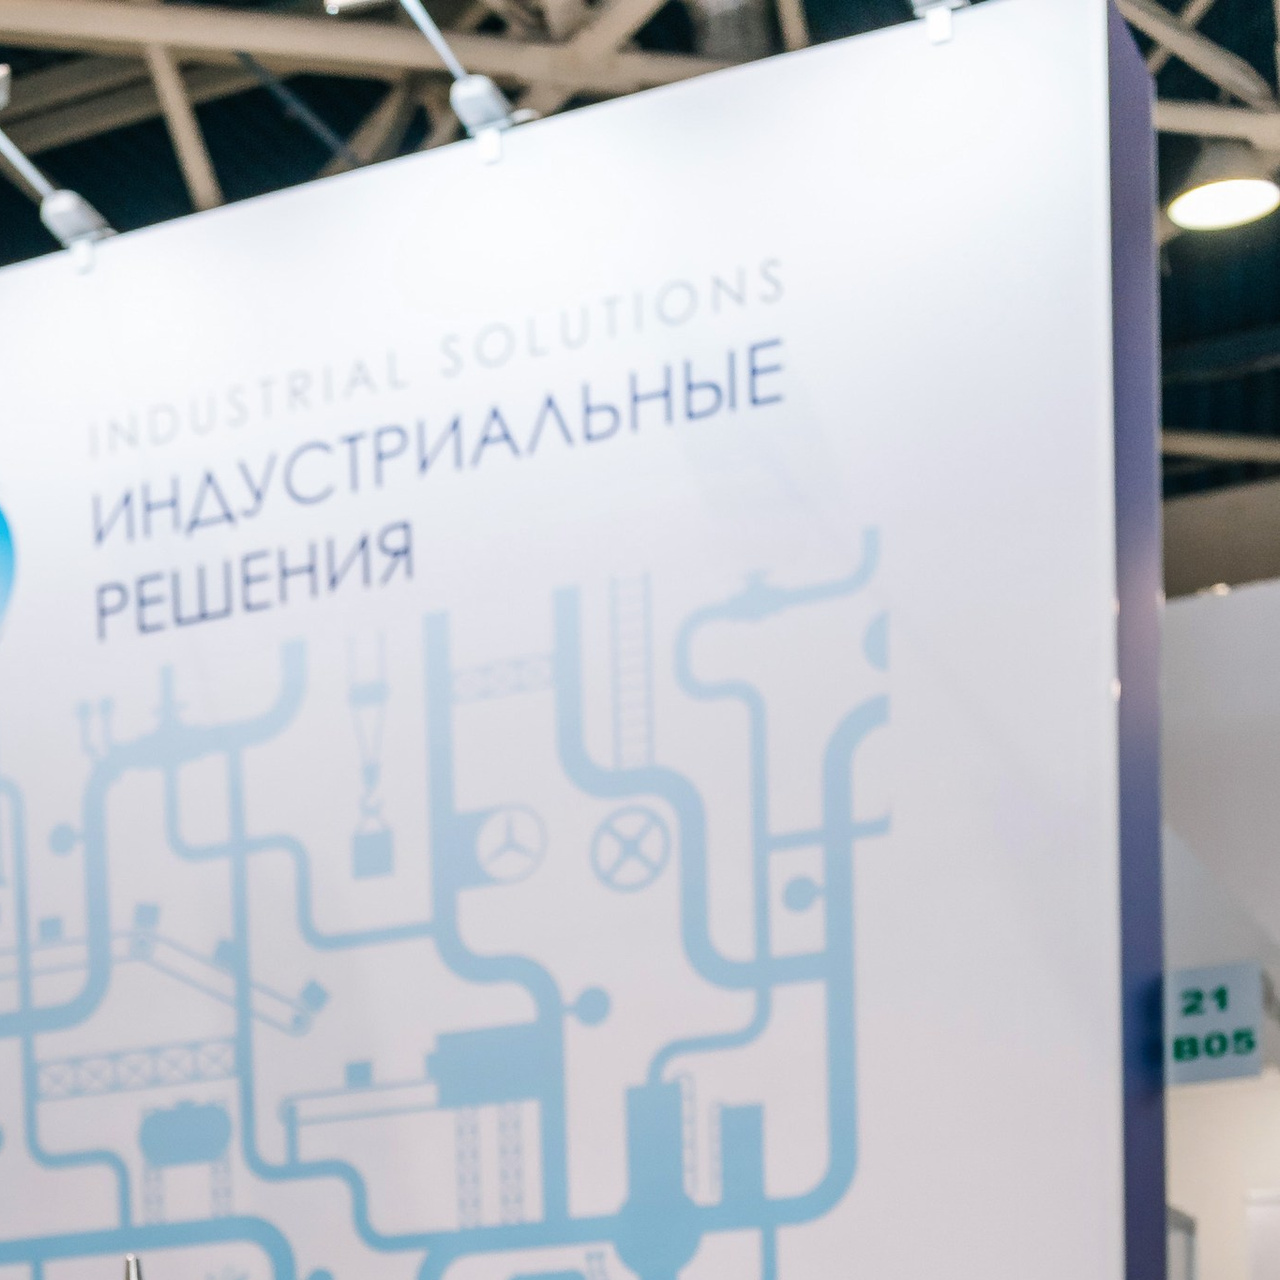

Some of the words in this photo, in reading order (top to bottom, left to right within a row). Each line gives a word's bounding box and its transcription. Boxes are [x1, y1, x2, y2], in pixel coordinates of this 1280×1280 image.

[87, 349, 410, 460] INDUSTRIAL
[438, 257, 787, 379] SOLUTIONS
[90, 337, 787, 548] ИНДУСТРИАЛЬНЫЕ
[95, 520, 416, 642] РЕШЕНИЯ
[1173, 1028, 1256, 1062] B05
[1181, 986, 1228, 1016] 21
